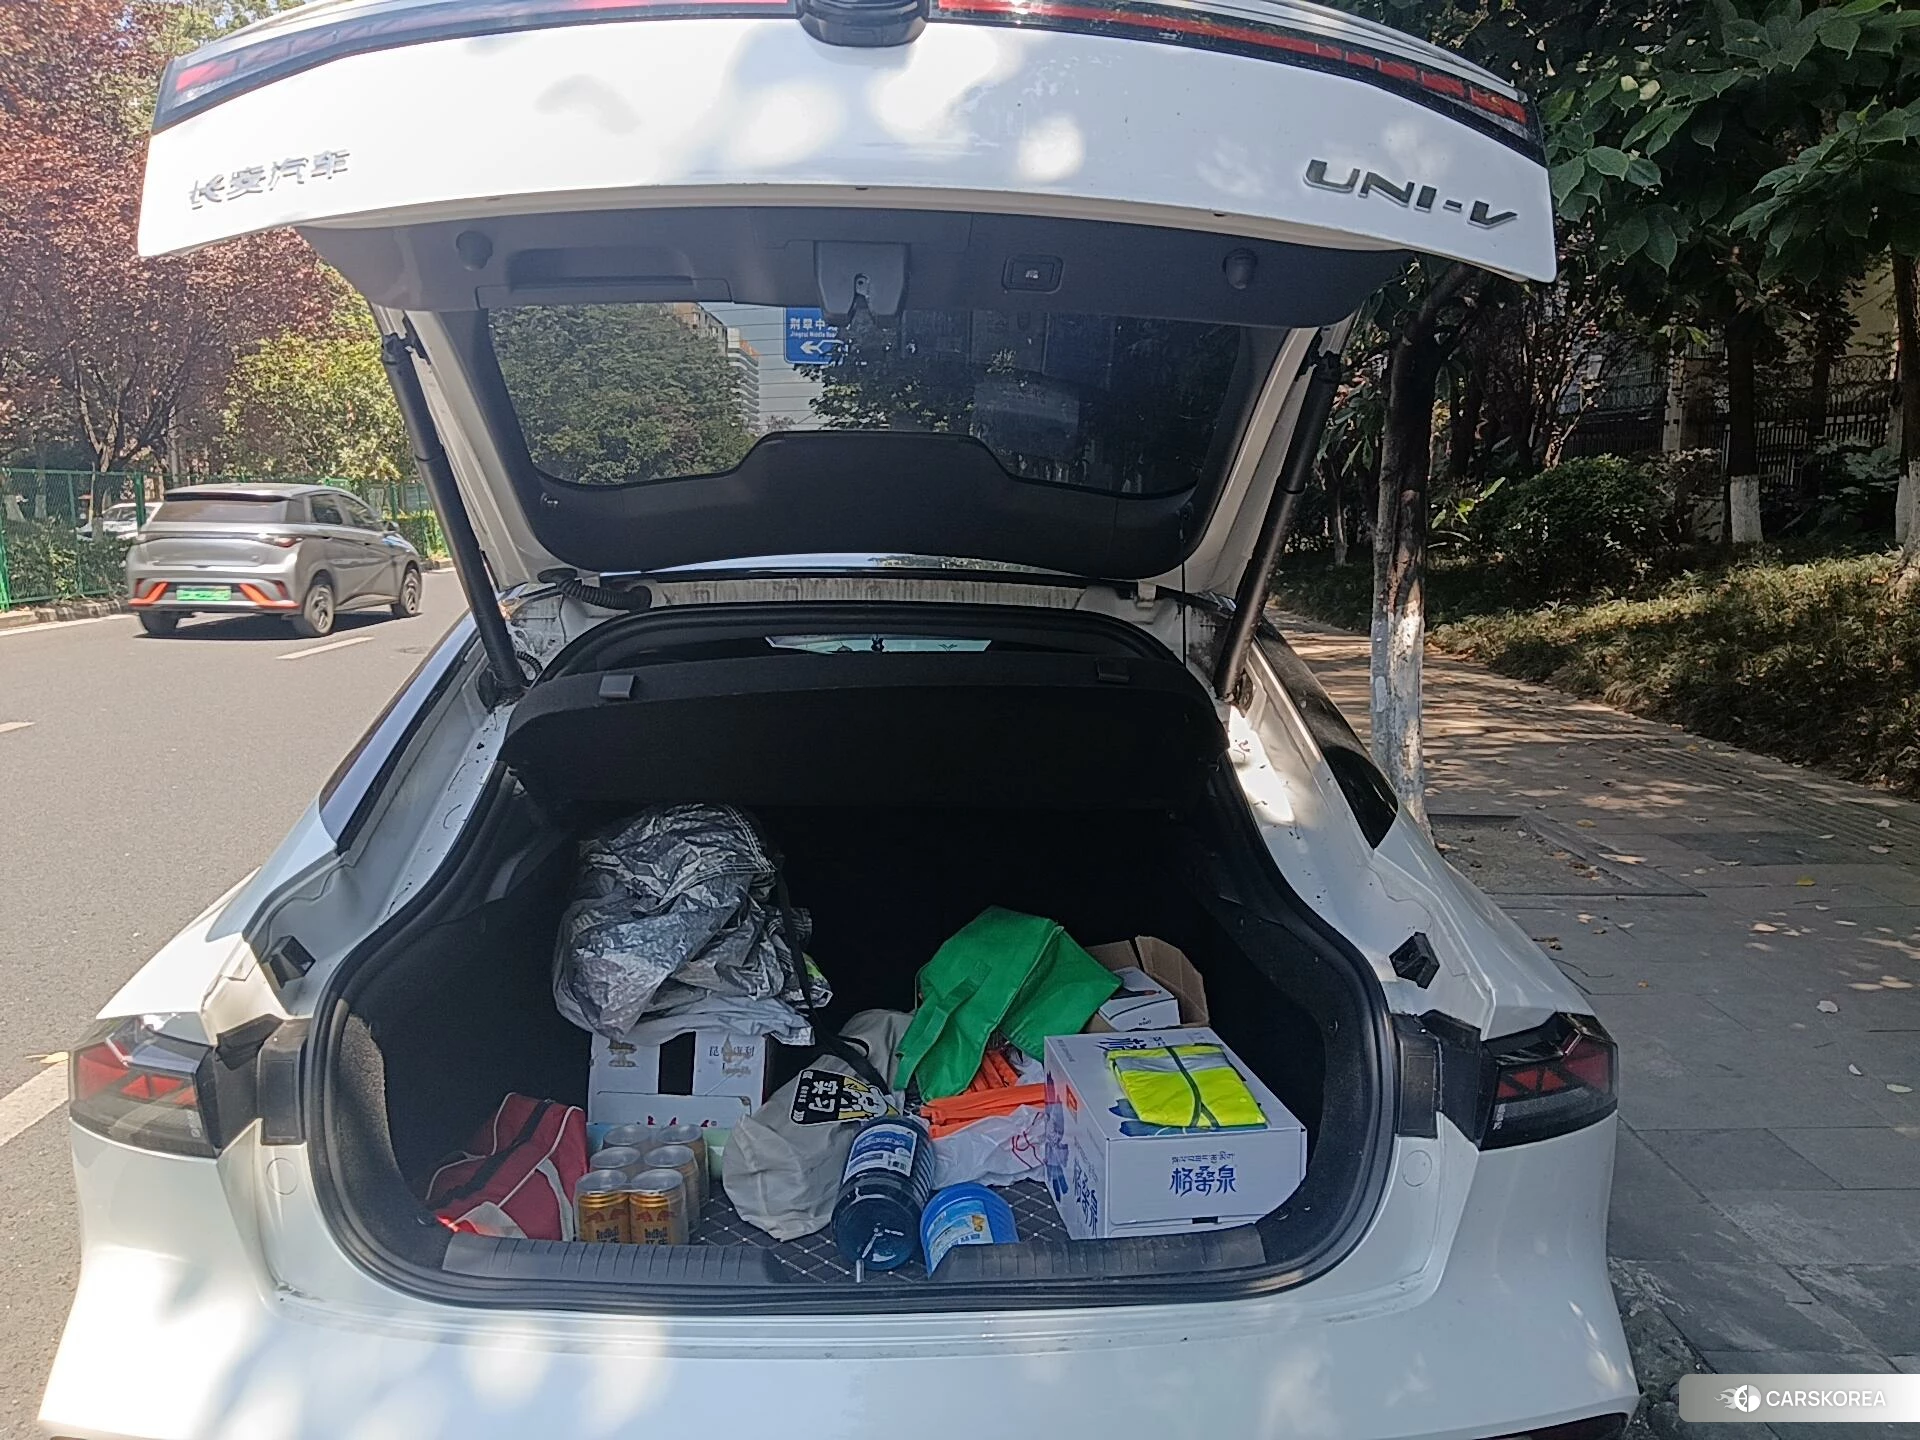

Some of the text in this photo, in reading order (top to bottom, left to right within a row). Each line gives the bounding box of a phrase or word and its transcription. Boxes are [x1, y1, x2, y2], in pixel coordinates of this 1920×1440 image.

[188, 149, 351, 210] 长安汽车
[1303, 159, 1518, 230] UNI-V
[1169, 1164, 1237, 1197] 格桑泉
